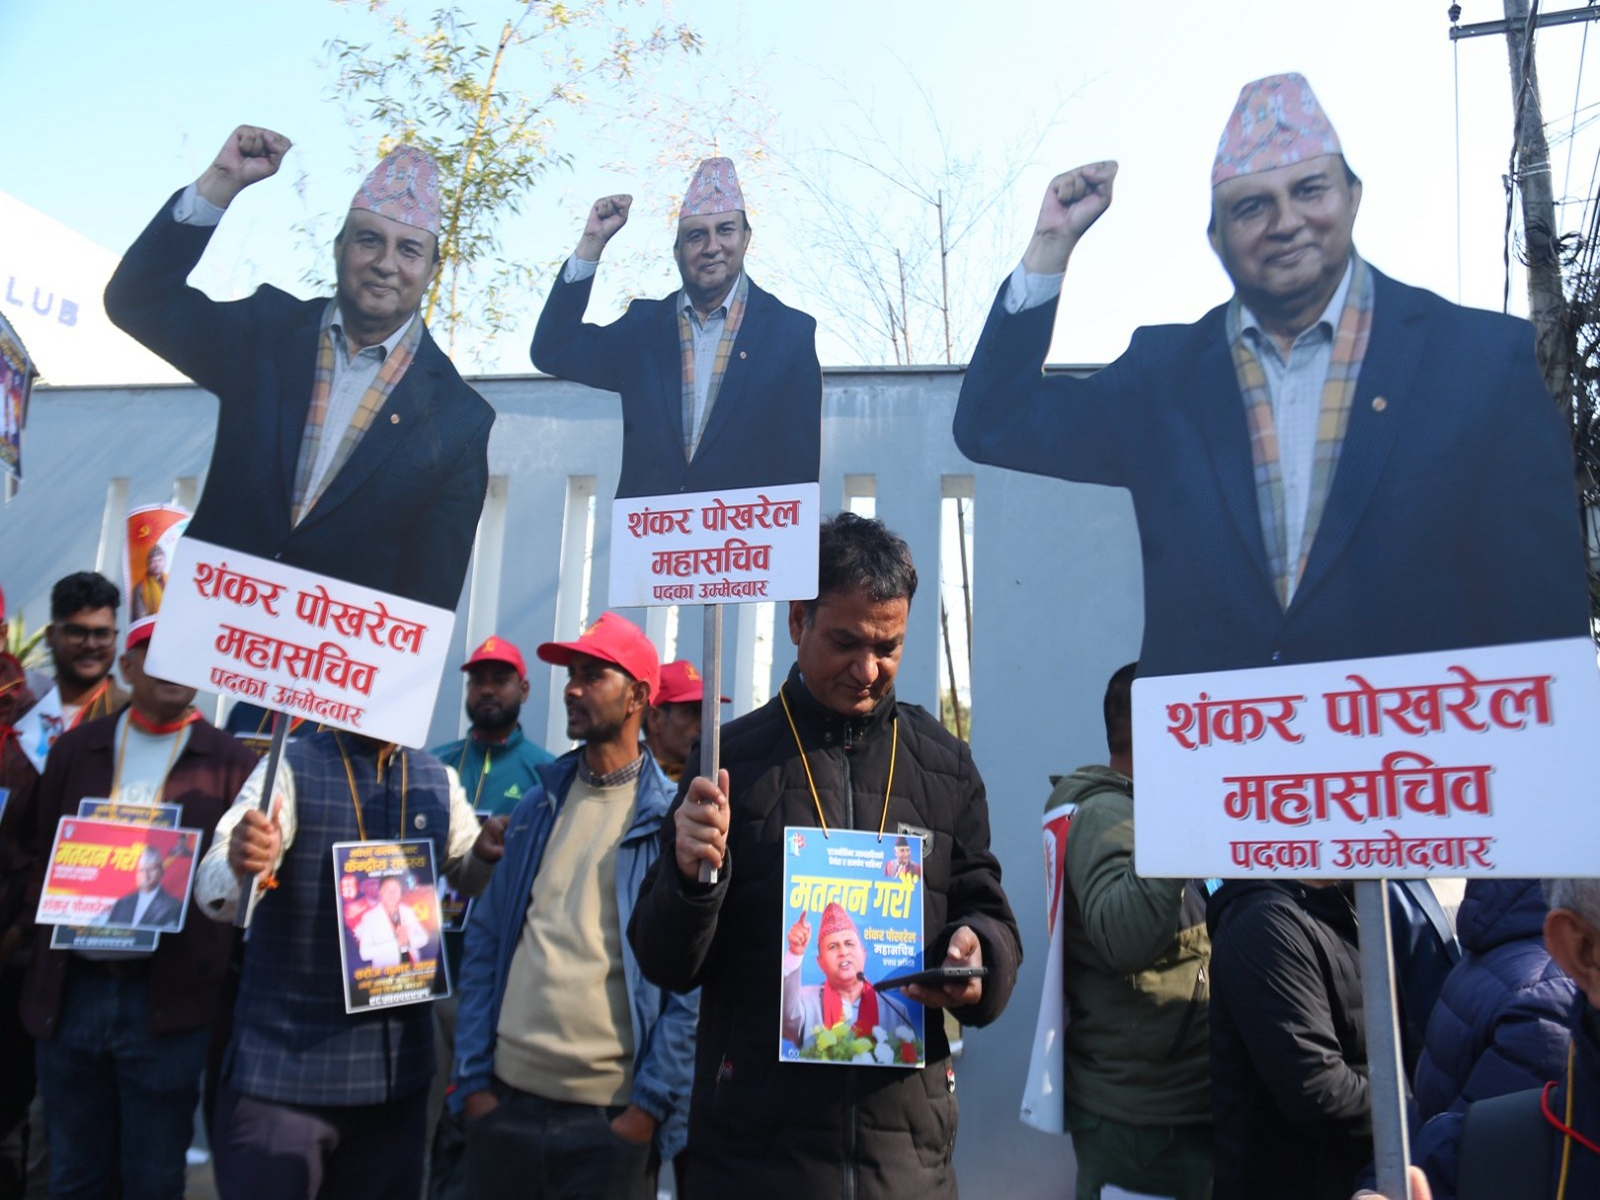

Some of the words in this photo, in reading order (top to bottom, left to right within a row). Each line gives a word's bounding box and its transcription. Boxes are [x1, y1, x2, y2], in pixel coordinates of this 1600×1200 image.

[628, 507, 693, 538] शंकर
[701, 494, 802, 531] पोखरेल
[651, 538, 772, 577] महासचिव
[193, 562, 287, 617] शंकर
[296, 585, 427, 655] पोखरेल
[653, 584, 694, 601] पदका
[699, 578, 768, 599] उम्मेदवार
[214, 623, 379, 697] महासचिव
[209, 666, 268, 699] पदका
[271, 684, 366, 727] उम्मेदवार
[1165, 692, 1305, 751] शंकर
[1322, 665, 1553, 738] पोखरेल
[1222, 751, 1495, 826] महासचिव
[55, 843, 111, 869] मतदान
[1229, 840, 1321, 872] पदका
[1331, 829, 1496, 872] उम्मेदवार
[790, 875, 872, 915] मतदान
[873, 872, 918, 918] गरौं
